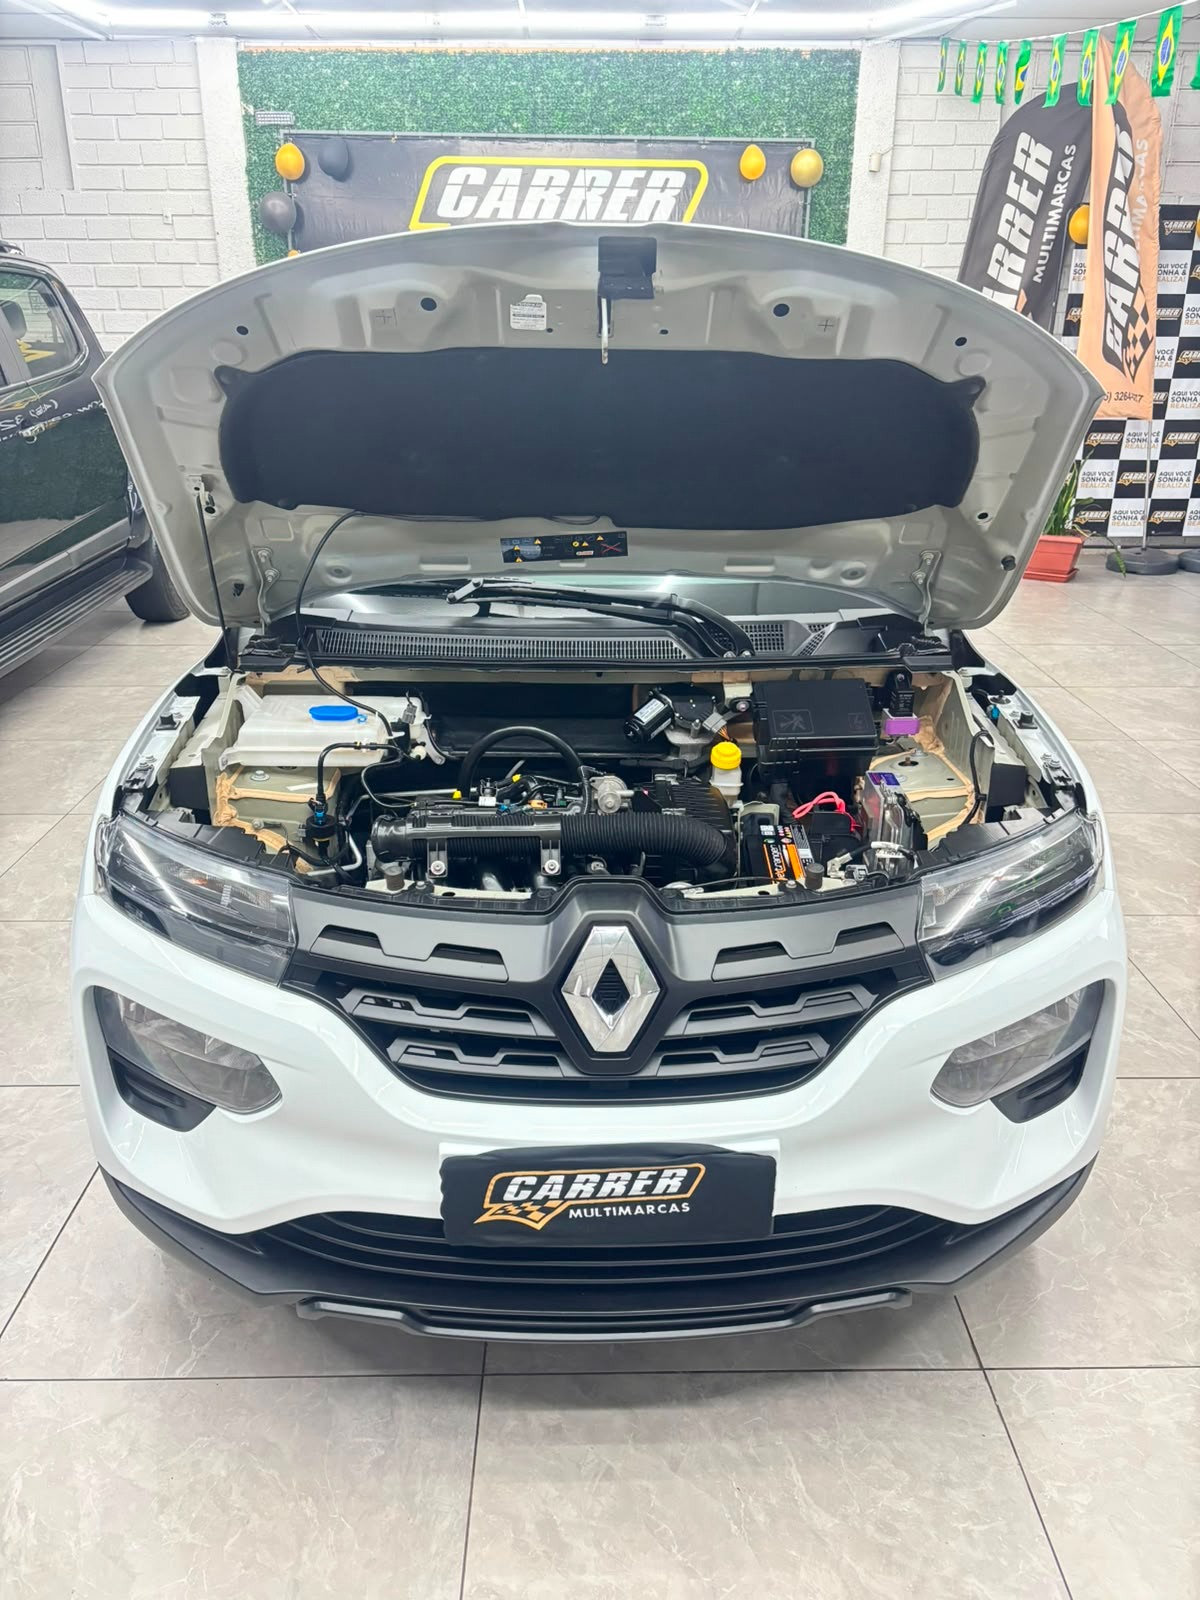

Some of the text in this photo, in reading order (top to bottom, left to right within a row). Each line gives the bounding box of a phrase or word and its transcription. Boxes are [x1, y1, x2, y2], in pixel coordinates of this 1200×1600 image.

[436, 166, 687, 221] CARRER
[1032, 144, 1077, 284] MULTIMARCAS
[502, 1168, 688, 1202] CARRER
[568, 1202, 690, 1219] MULTIMARCAS
